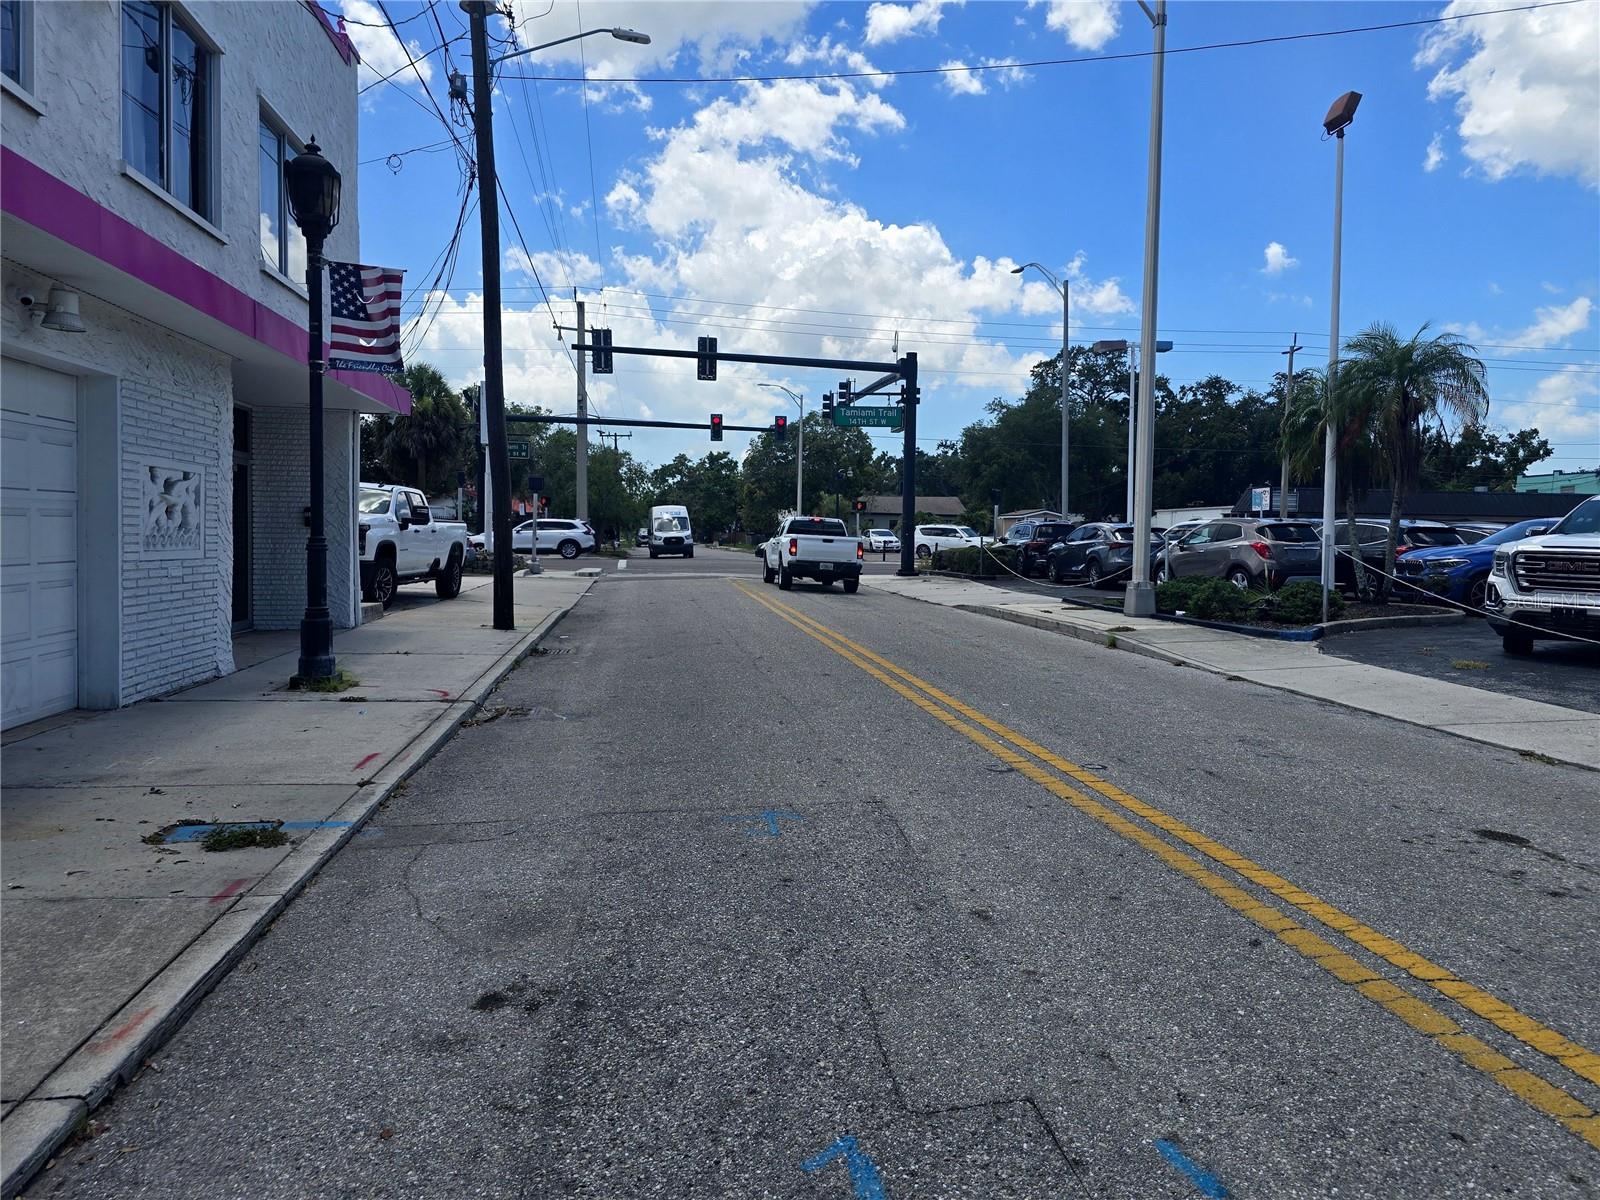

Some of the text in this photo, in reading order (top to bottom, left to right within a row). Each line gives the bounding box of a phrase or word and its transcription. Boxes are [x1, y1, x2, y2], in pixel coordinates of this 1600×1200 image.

[348, 361, 380, 373] Friendly
[381, 364, 398, 373] City
[840, 408, 897, 417] Tamiami Trail
[1547, 561, 1600, 571] GMC
